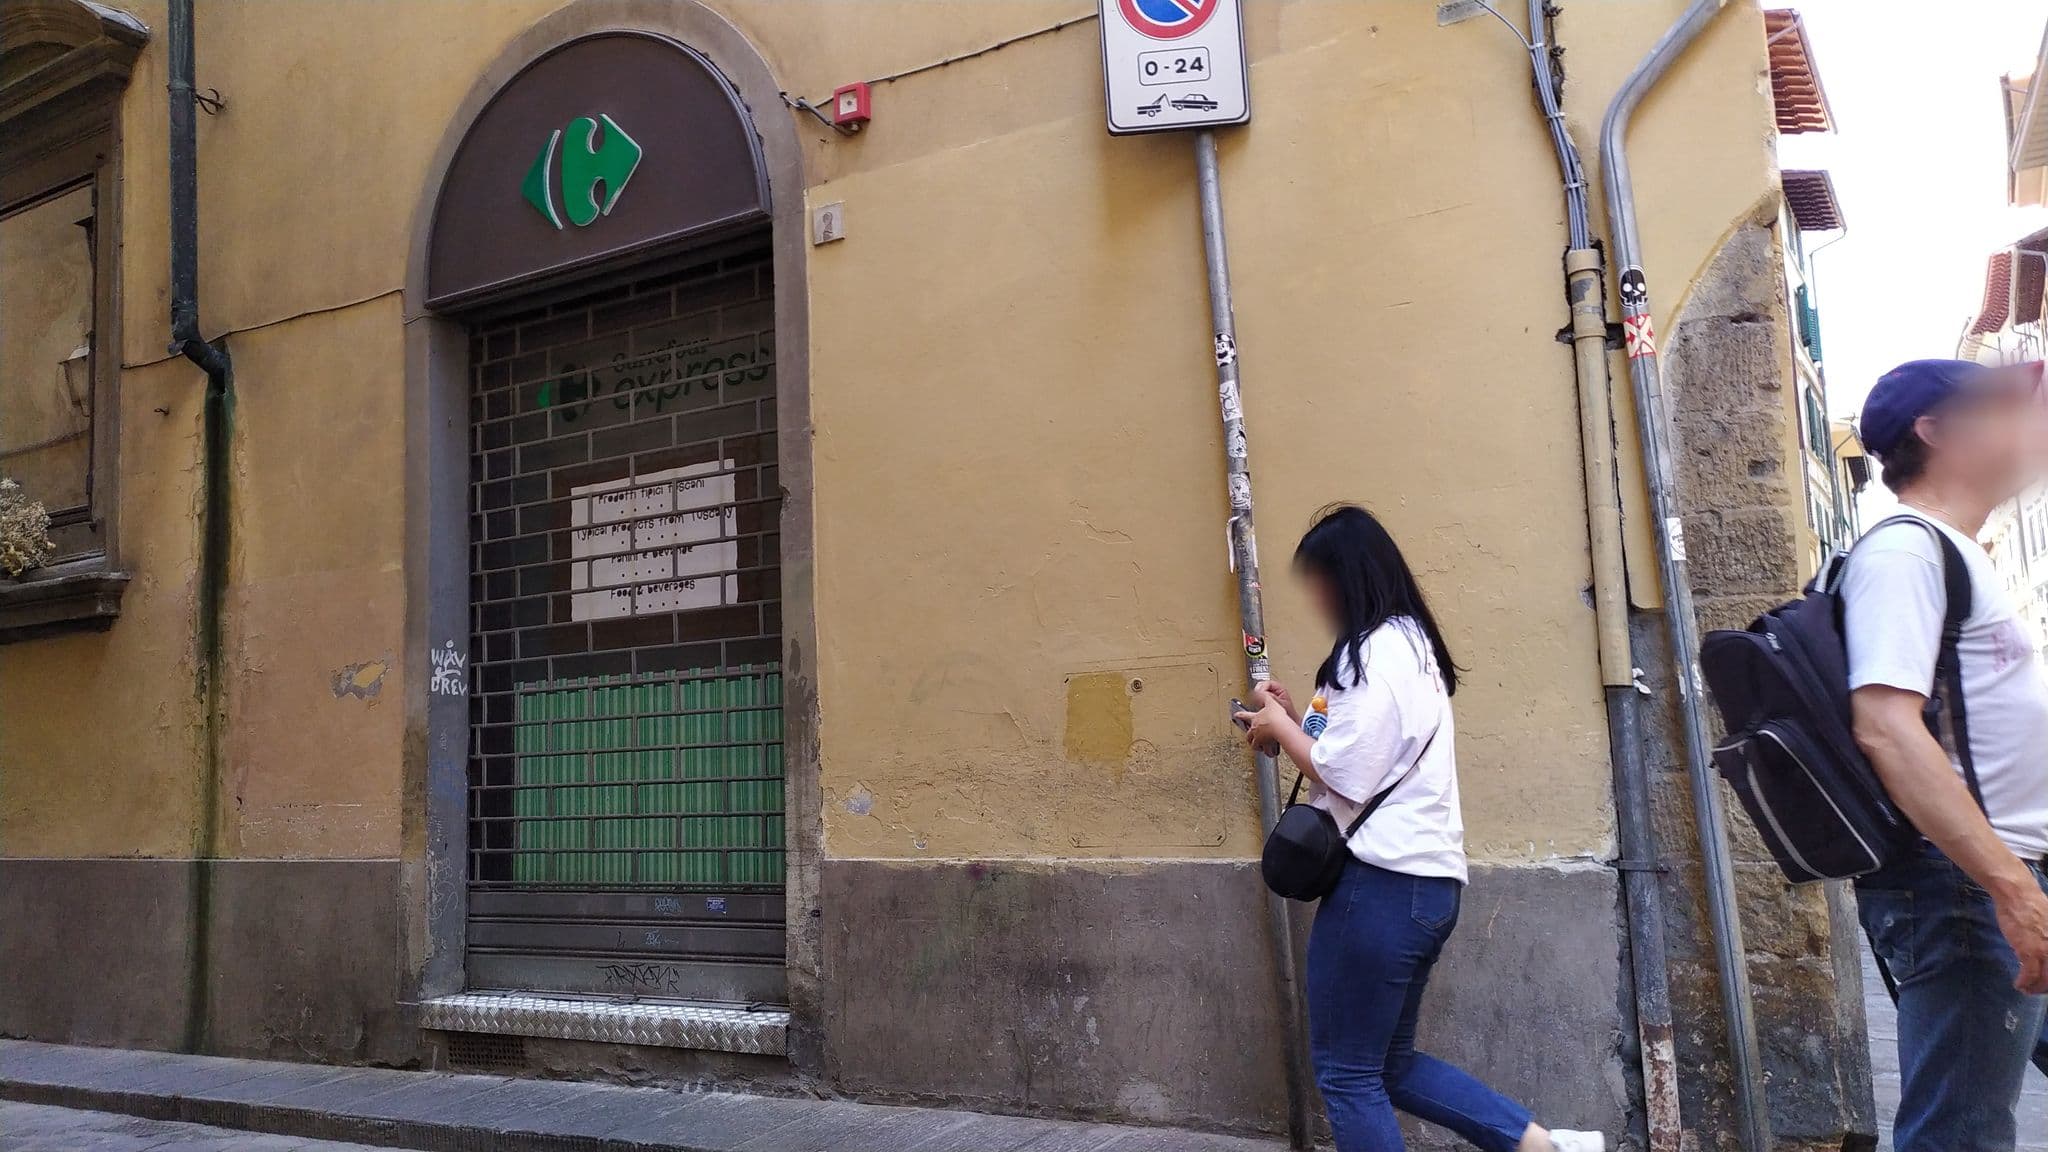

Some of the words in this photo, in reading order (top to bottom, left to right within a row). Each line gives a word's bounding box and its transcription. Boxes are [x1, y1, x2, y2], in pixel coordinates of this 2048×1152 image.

[613, 346, 769, 413] express
[577, 526, 608, 541] Typical
[659, 514, 685, 527] from
[692, 506, 733, 522] Tuscay
[648, 579, 696, 594] beverages
